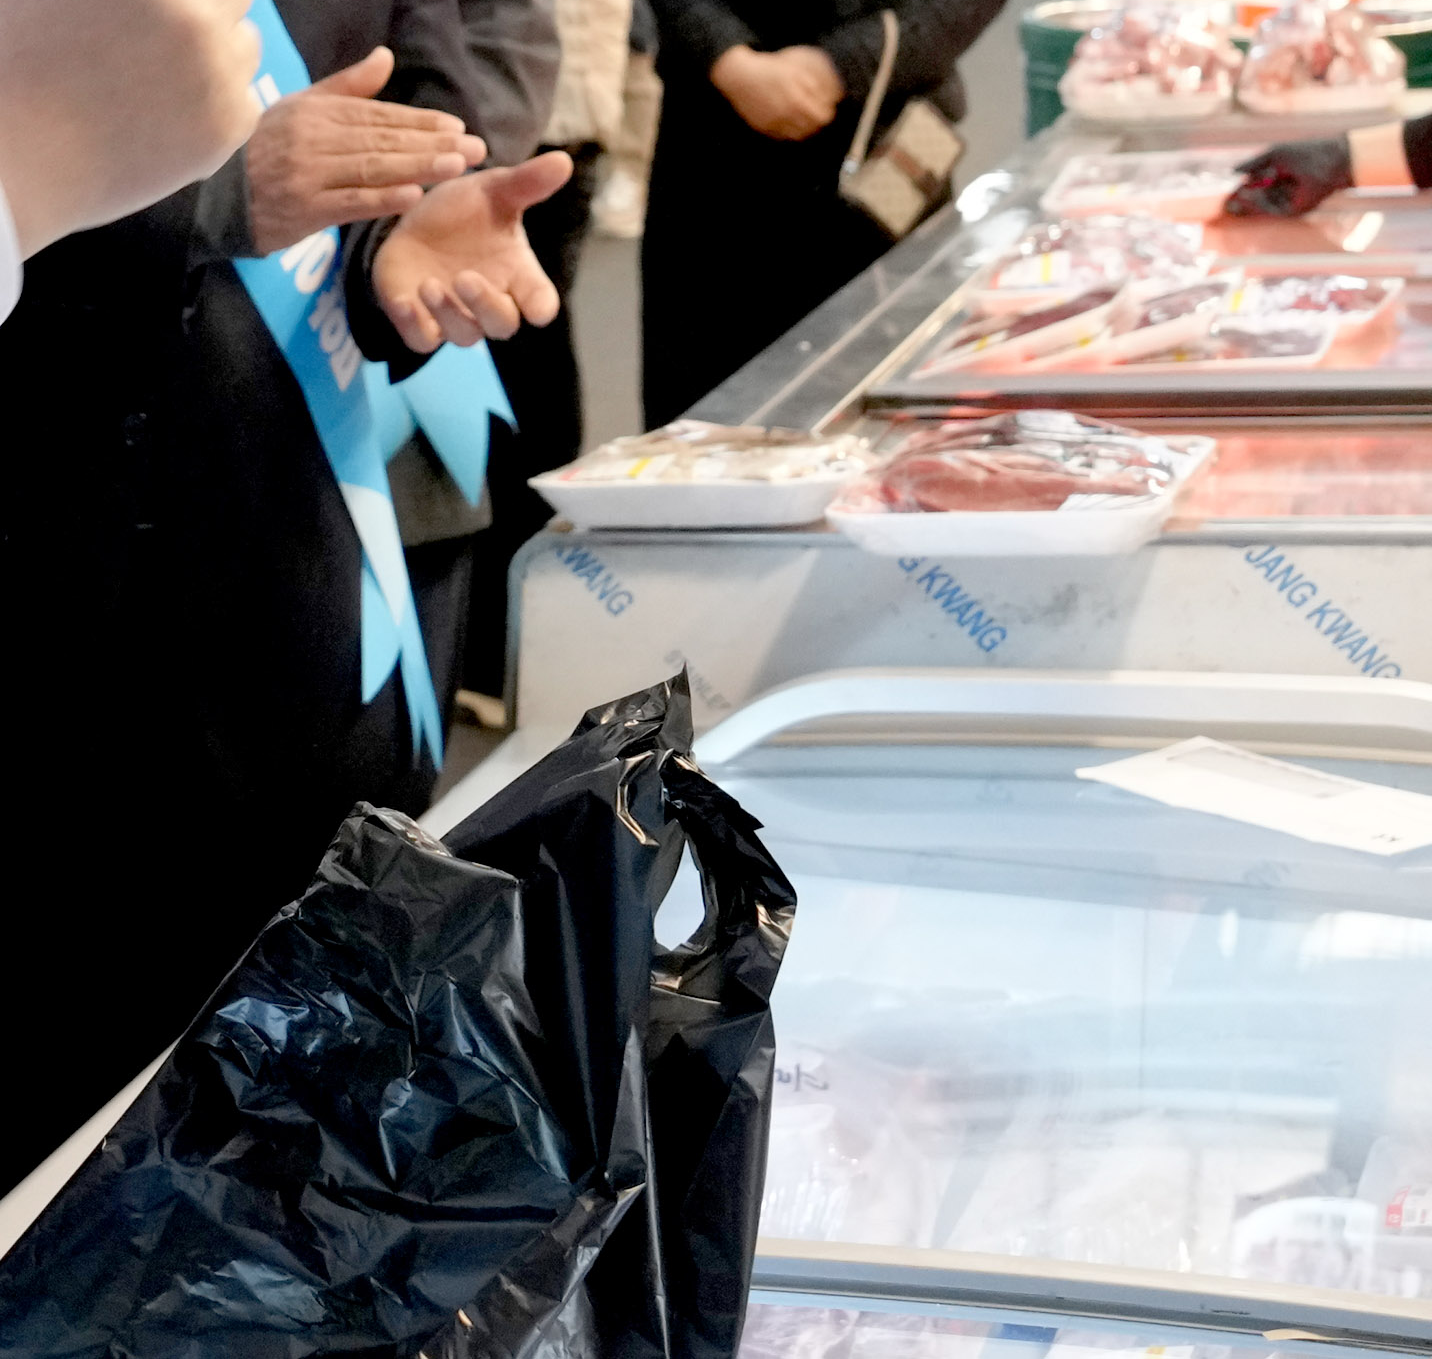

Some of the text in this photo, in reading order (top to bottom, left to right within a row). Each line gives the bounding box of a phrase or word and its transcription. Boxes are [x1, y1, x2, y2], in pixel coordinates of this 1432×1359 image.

[916, 564, 1008, 653] KWANG
[1243, 544, 1402, 679] JANG KWANG
